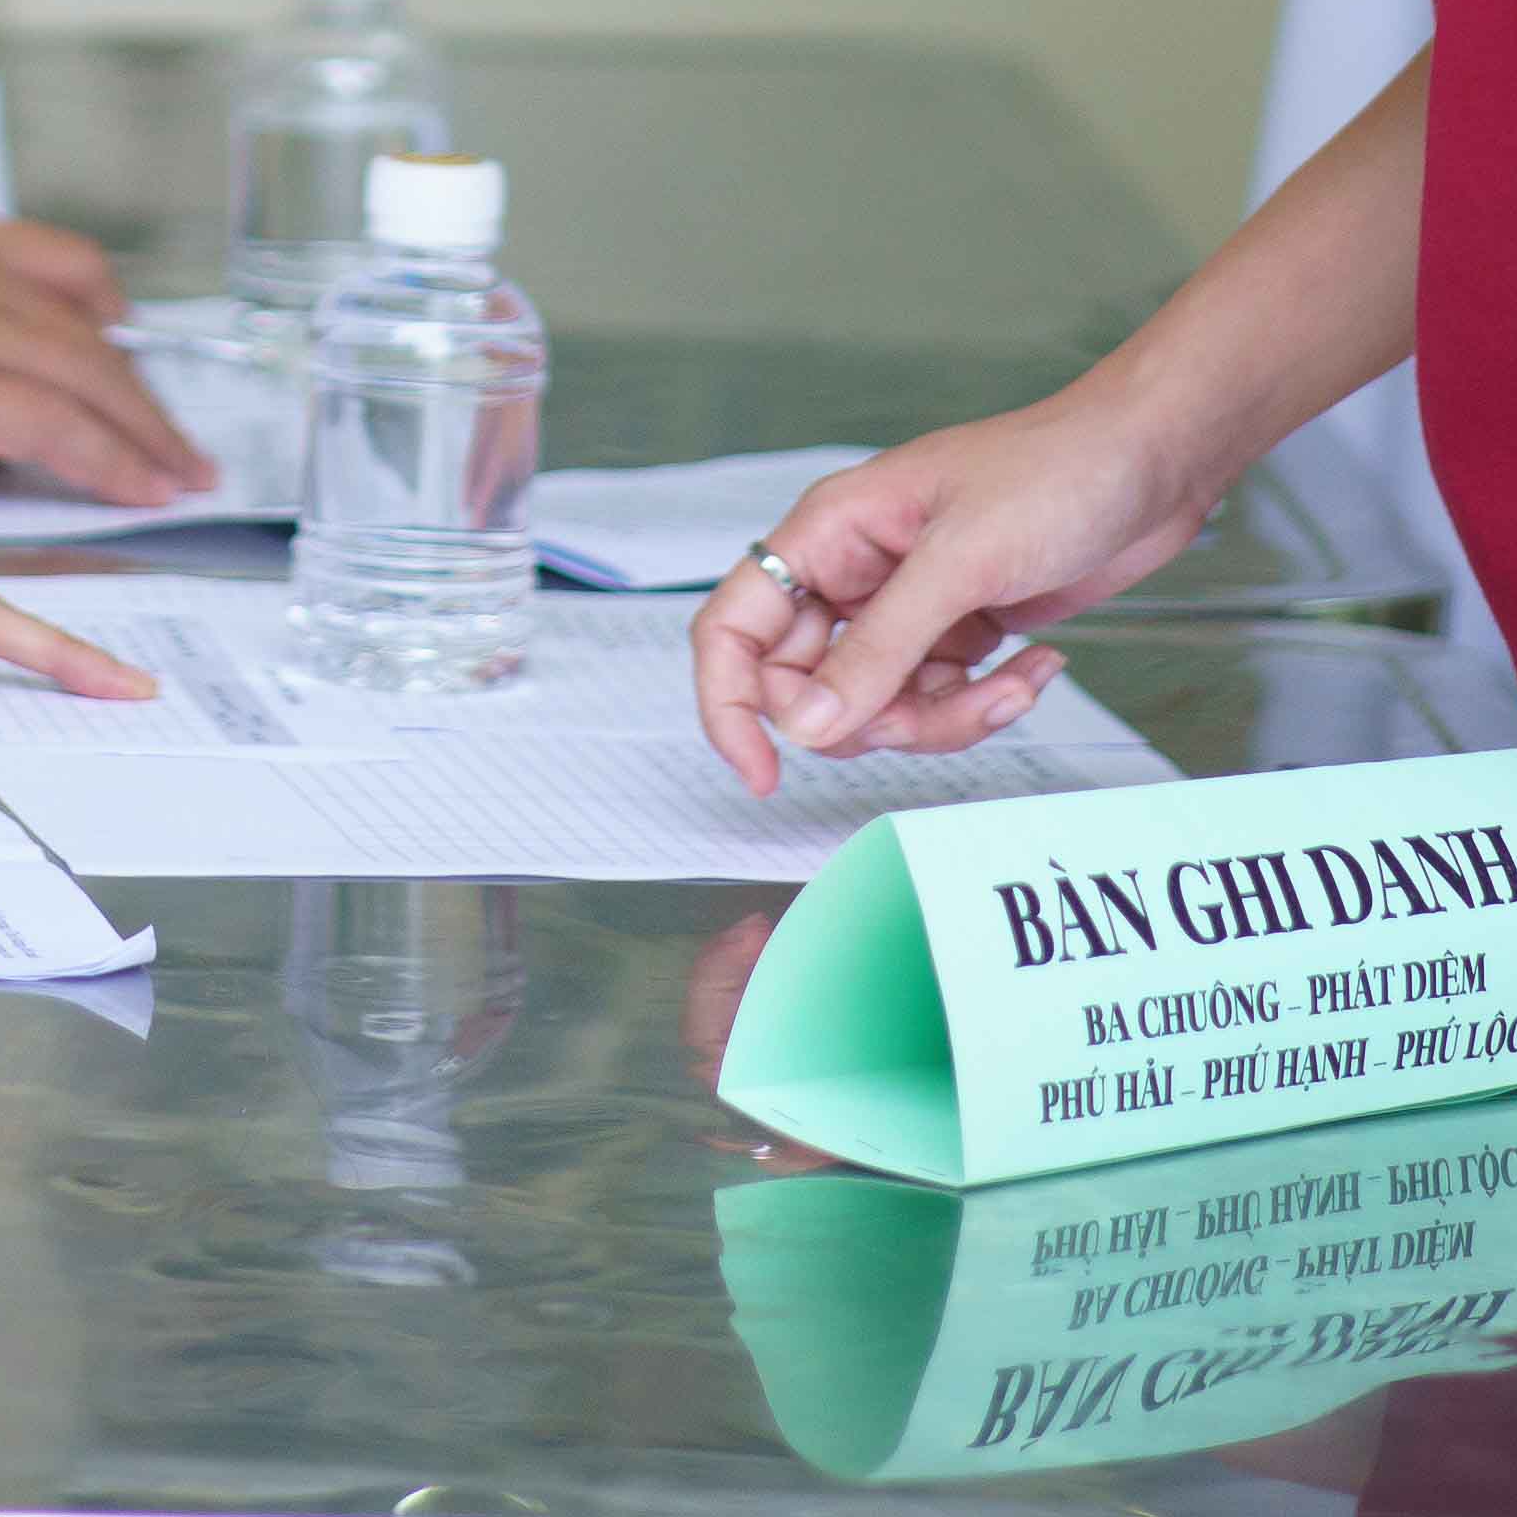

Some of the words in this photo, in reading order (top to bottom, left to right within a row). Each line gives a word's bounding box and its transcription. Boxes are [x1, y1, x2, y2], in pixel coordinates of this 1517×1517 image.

[992, 855, 1158, 968] BÀN
[1166, 850, 1314, 945] GHI
[1082, 1001, 1133, 1047] BA
[1137, 979, 1281, 1039] CHUÔNG
[1306, 958, 1396, 1016] PHÁT
[1402, 949, 1487, 1004] DIỆM
[1038, 1065, 1106, 1124] PHÚ
[1114, 1057, 1175, 1114] HẢI
[1201, 1042, 1270, 1100] PHÚ
[1274, 1037, 1369, 1092] HẠNH
[1392, 1016, 1462, 1071] PHÚ
